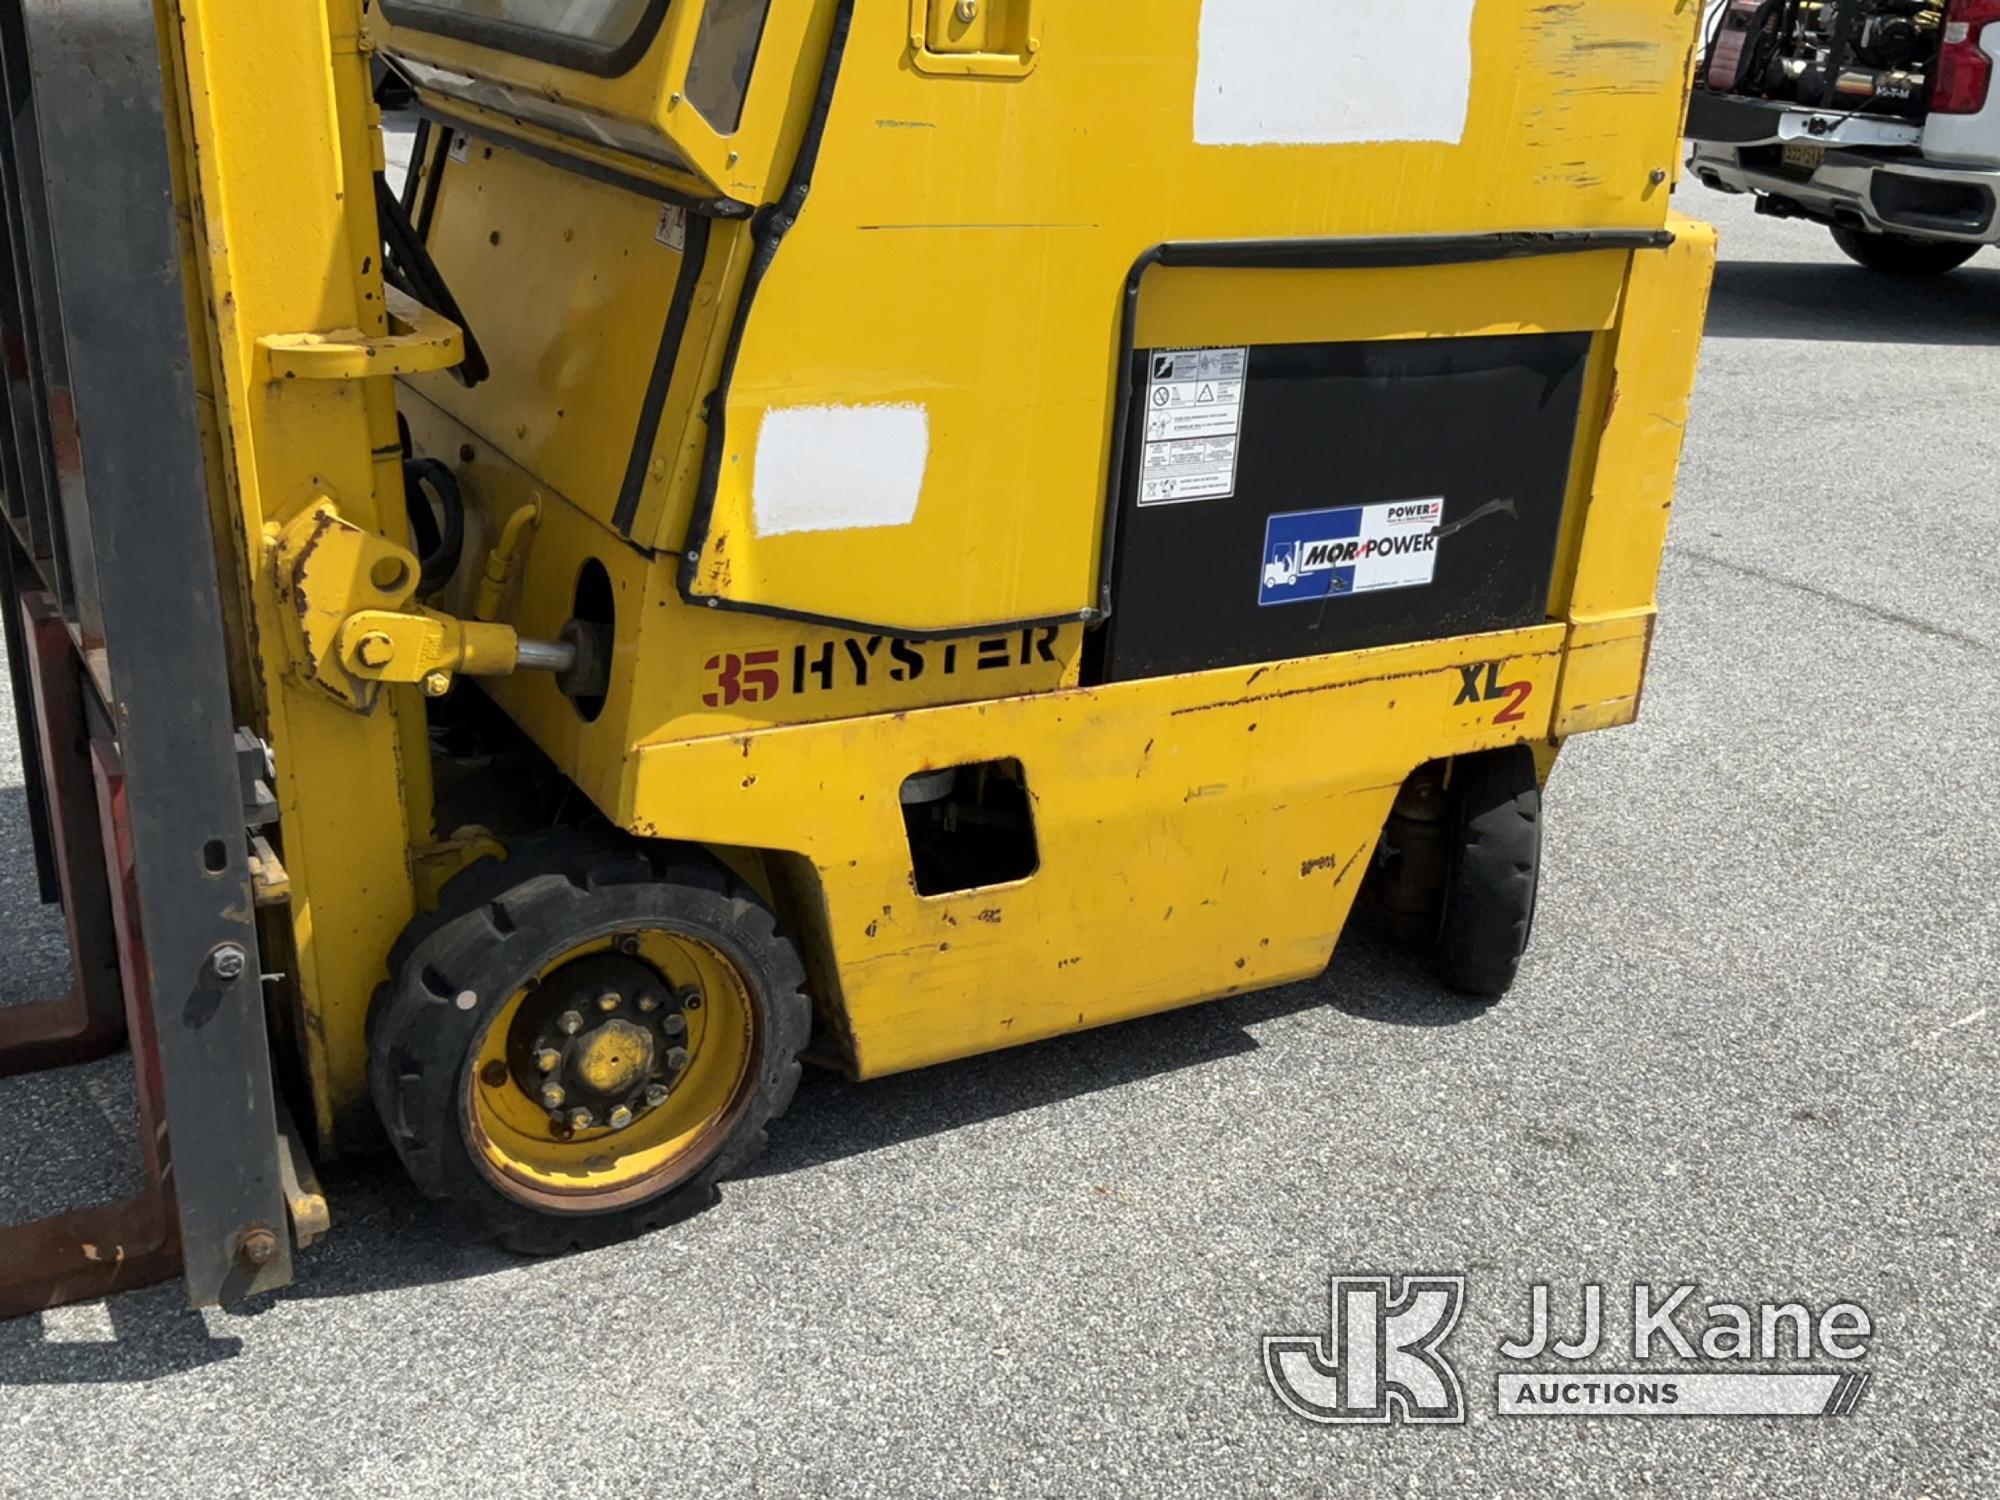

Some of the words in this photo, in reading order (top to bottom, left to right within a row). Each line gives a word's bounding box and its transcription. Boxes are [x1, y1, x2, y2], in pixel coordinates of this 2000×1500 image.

[1365, 533, 1435, 559] POWER
[702, 649, 780, 708] 35
[792, 626, 1060, 694] HYSTER
